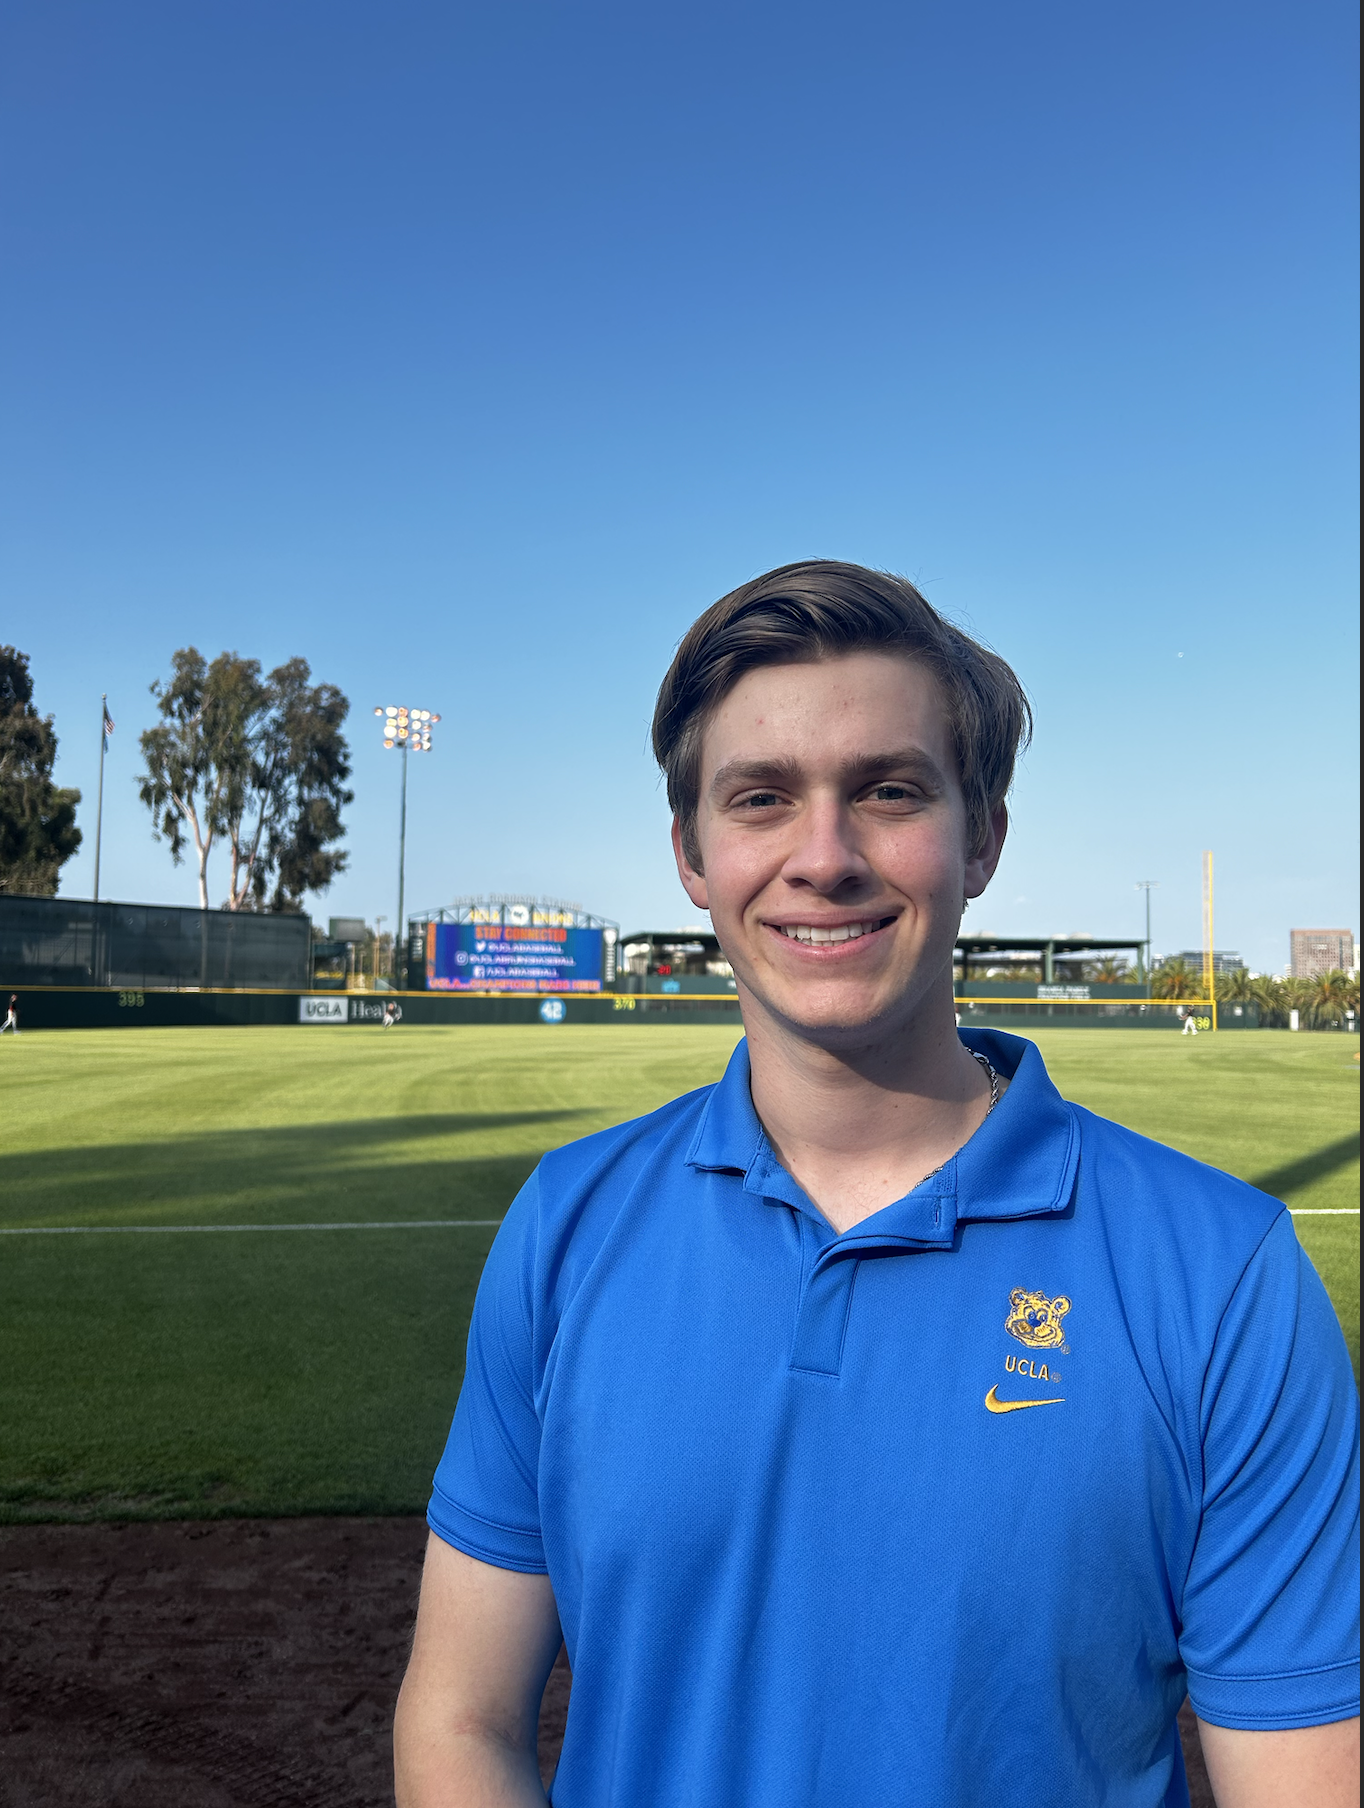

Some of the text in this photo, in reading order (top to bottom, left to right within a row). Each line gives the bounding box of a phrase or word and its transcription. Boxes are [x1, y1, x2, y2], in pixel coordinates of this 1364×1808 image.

[470, 908, 574, 924] UCLA BRUINS
[475, 926, 567, 942] STAY CONNECTED
[118, 990, 145, 1008] 395
[614, 997, 636, 1011] 370
[306, 1000, 403, 1019] UCLA Healh
[541, 1001, 563, 1020] 42
[1004, 1354, 1050, 1382] UCLA
